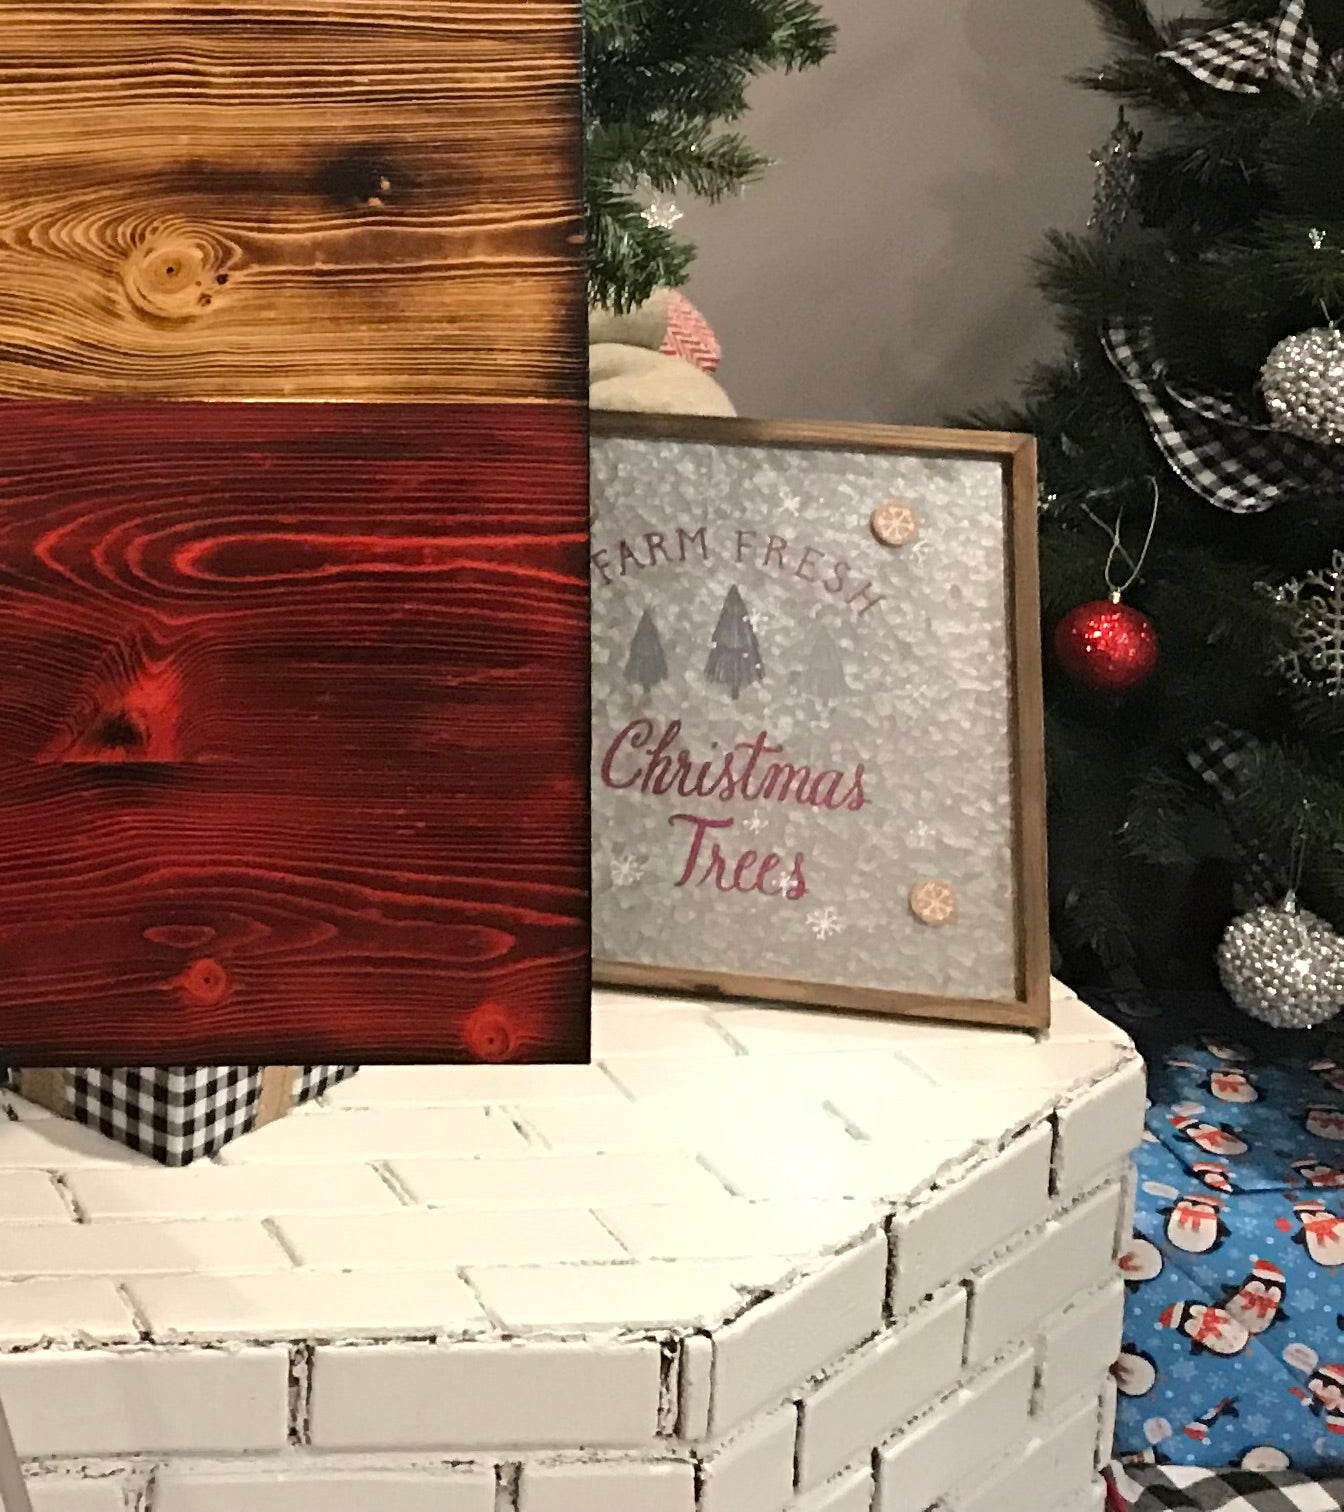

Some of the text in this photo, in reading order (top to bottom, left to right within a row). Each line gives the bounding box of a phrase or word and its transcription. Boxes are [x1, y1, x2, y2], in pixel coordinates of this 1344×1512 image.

[590, 526, 889, 617] FARM FRESH
[599, 718, 872, 812] Christmas
[667, 813, 810, 901] Trees
